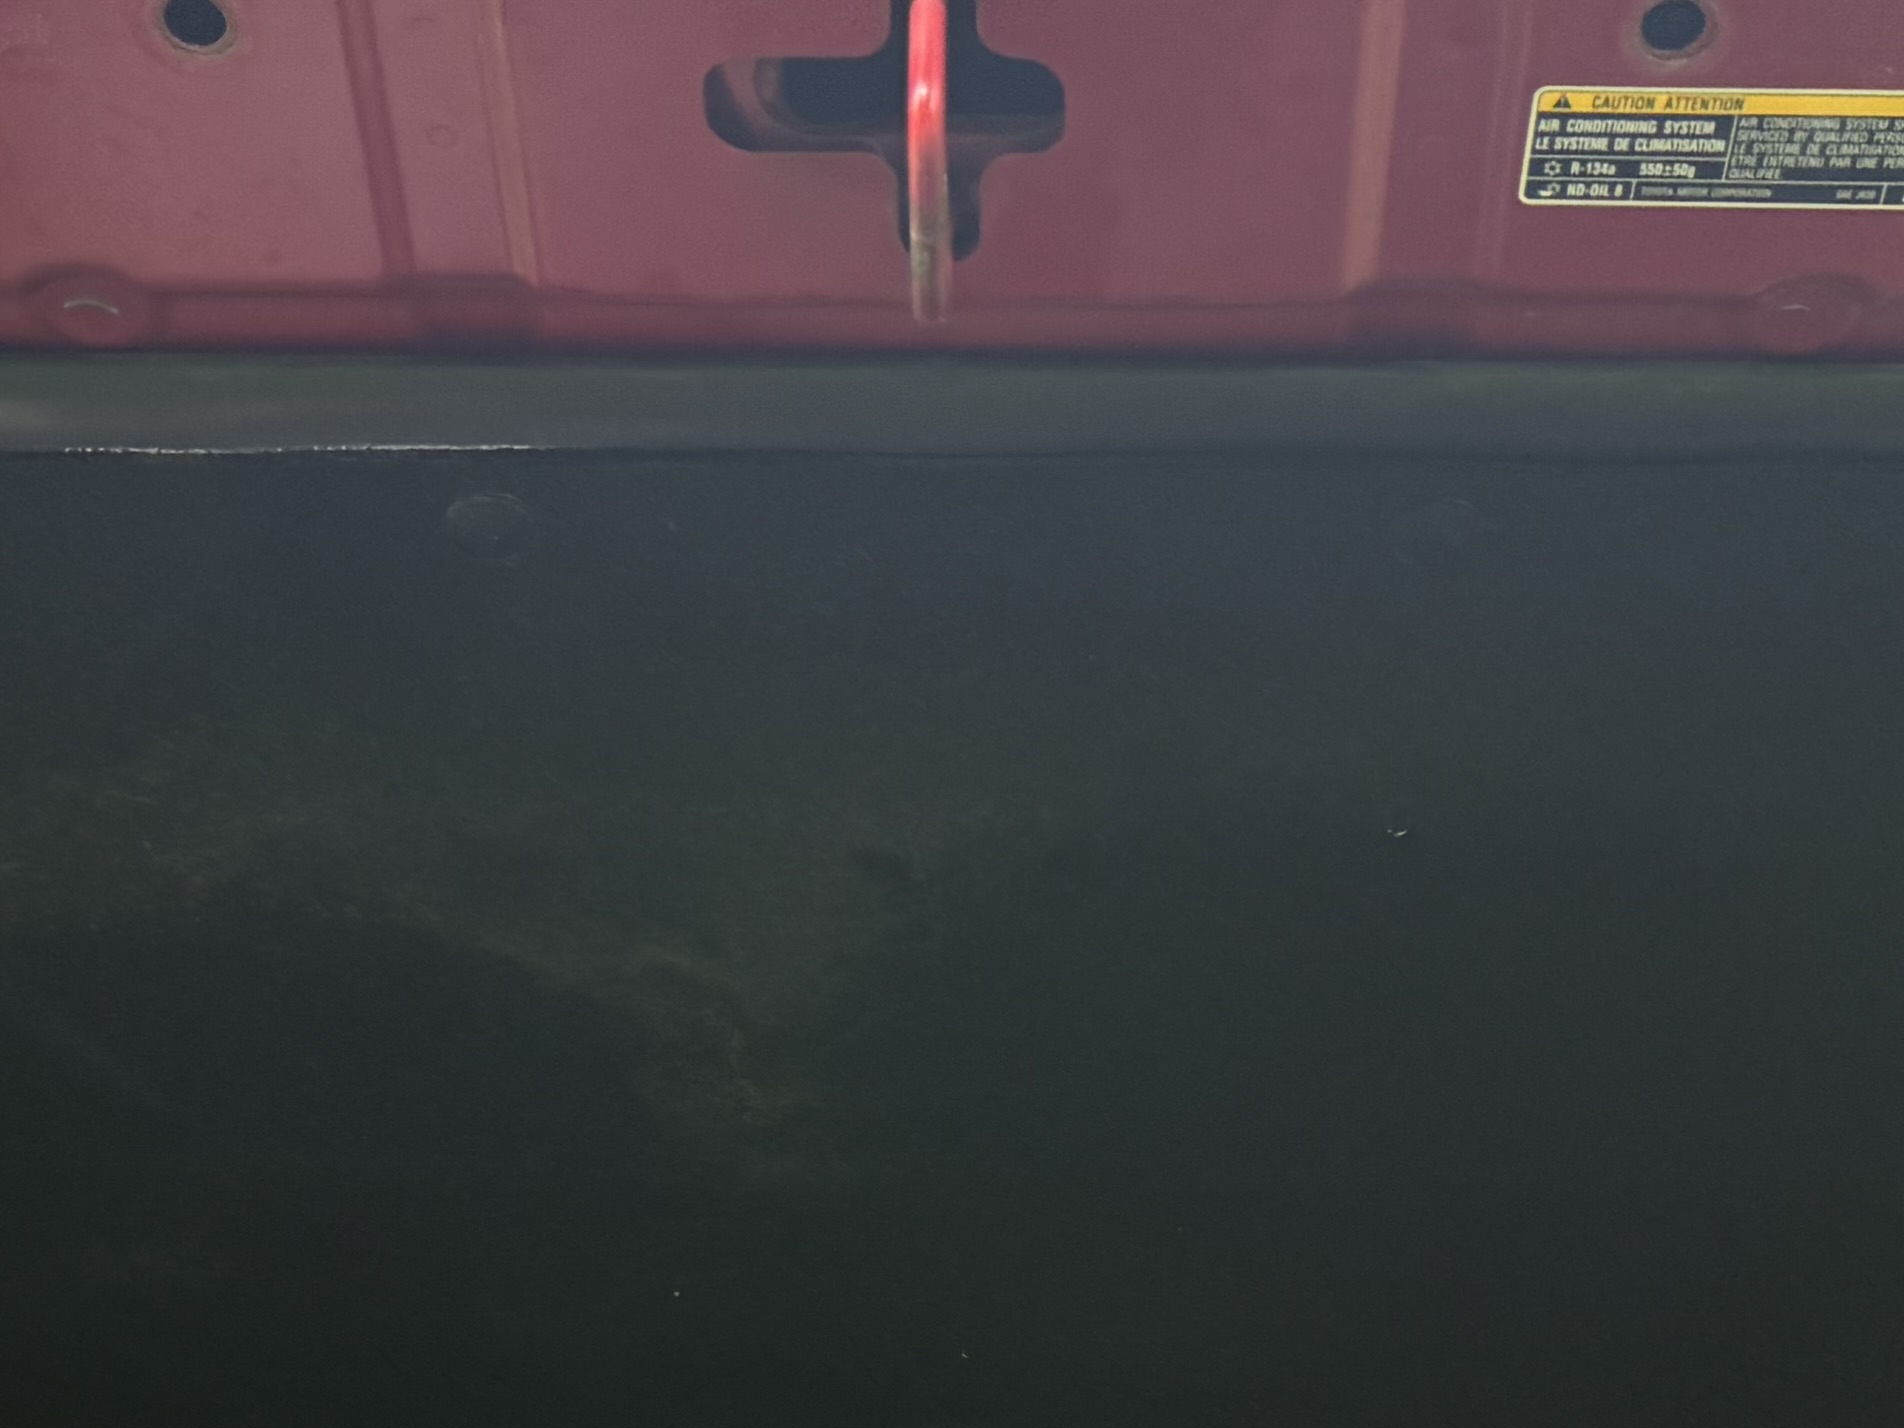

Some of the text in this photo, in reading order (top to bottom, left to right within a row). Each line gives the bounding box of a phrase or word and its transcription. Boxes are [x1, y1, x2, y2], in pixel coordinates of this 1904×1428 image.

[1591, 94, 1746, 112] CAUTION ATTENTION
[1538, 118, 1716, 137] AIR CONDITIONING SYSTEM
[1739, 116, 1760, 130] AIR
[1763, 117, 1842, 132] CONDITIONING
[1845, 118, 1891, 132] SYSTEM
[1737, 129, 1788, 144] SERVICED
[1793, 130, 1811, 144] BY
[1813, 130, 1870, 145] QUALIFIED
[1536, 137, 1552, 151] LE
[1613, 138, 1631, 153] DE
[1634, 137, 1727, 154] CLIMATISATION
[1806, 143, 1821, 157] DE
[1570, 161, 1617, 177] R-134a
[1762, 155, 1824, 170] ENTRETENU
[1828, 155, 1850, 170] PAR
[1855, 156, 1878, 170] UNE
[1567, 183, 1624, 198] ND-OIL 8
